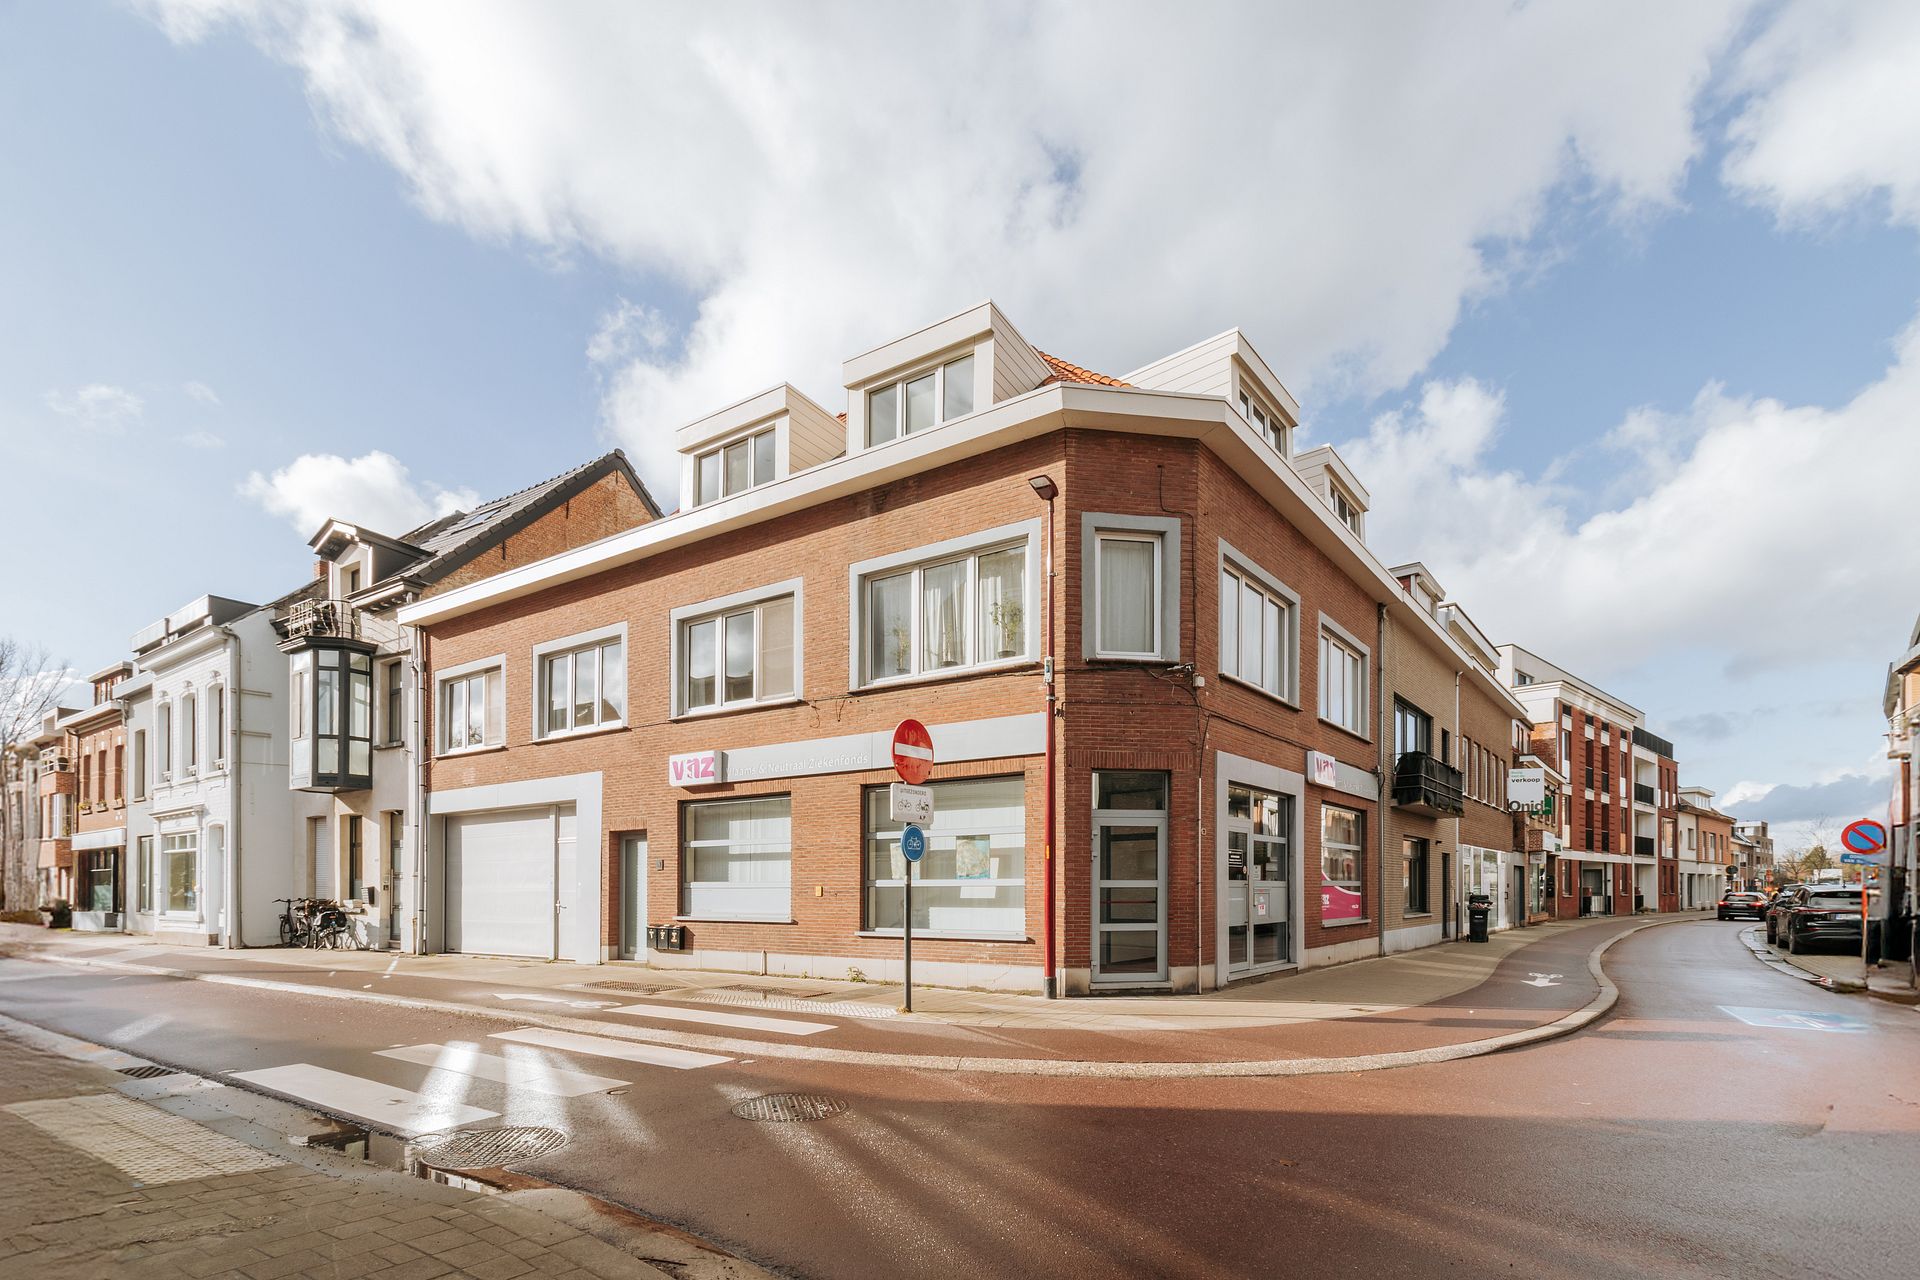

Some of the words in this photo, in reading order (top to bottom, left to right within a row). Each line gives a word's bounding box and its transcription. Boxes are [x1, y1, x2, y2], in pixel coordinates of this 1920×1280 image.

[726, 767, 756, 777] Vlaams
[758, 764, 767, 775] &
[768, 760, 806, 774] Neutraal
[809, 754, 868, 769] Ziekenfonds
